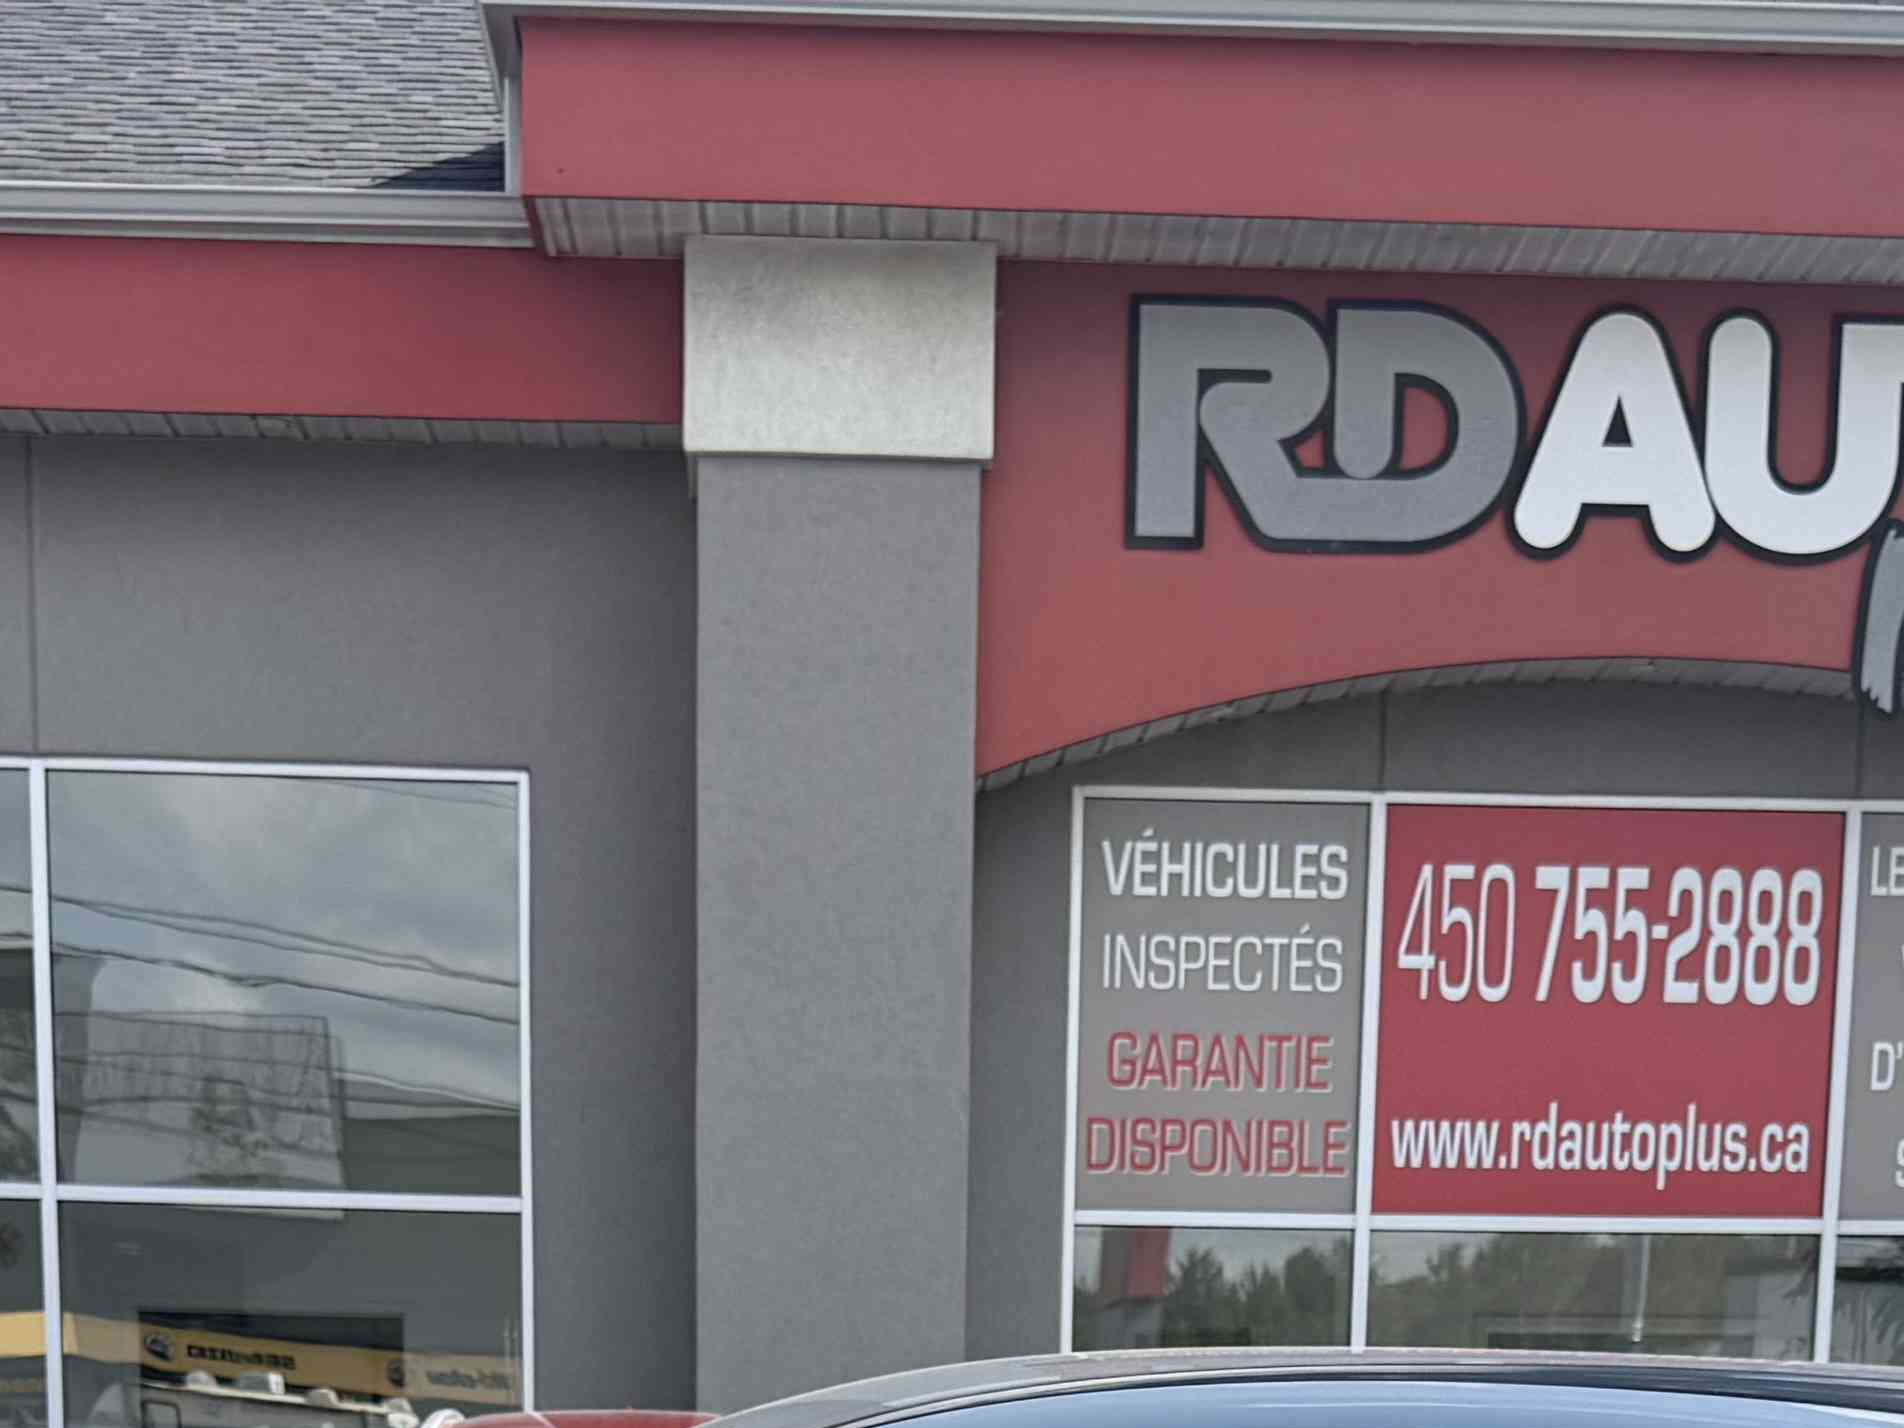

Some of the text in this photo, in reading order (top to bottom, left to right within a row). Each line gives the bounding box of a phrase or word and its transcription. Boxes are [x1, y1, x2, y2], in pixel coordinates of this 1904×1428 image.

[1101, 828, 1349, 900] VÉHICULES
[1102, 922, 1343, 993] INSPECTÉS
[1397, 863, 1824, 1006] 450 755-2888
[1107, 1031, 1335, 1092] GARANTIE
[1087, 1116, 1350, 1178] DISPONIBLE
[1391, 1101, 1810, 1191] www.rdautoplus.ca
